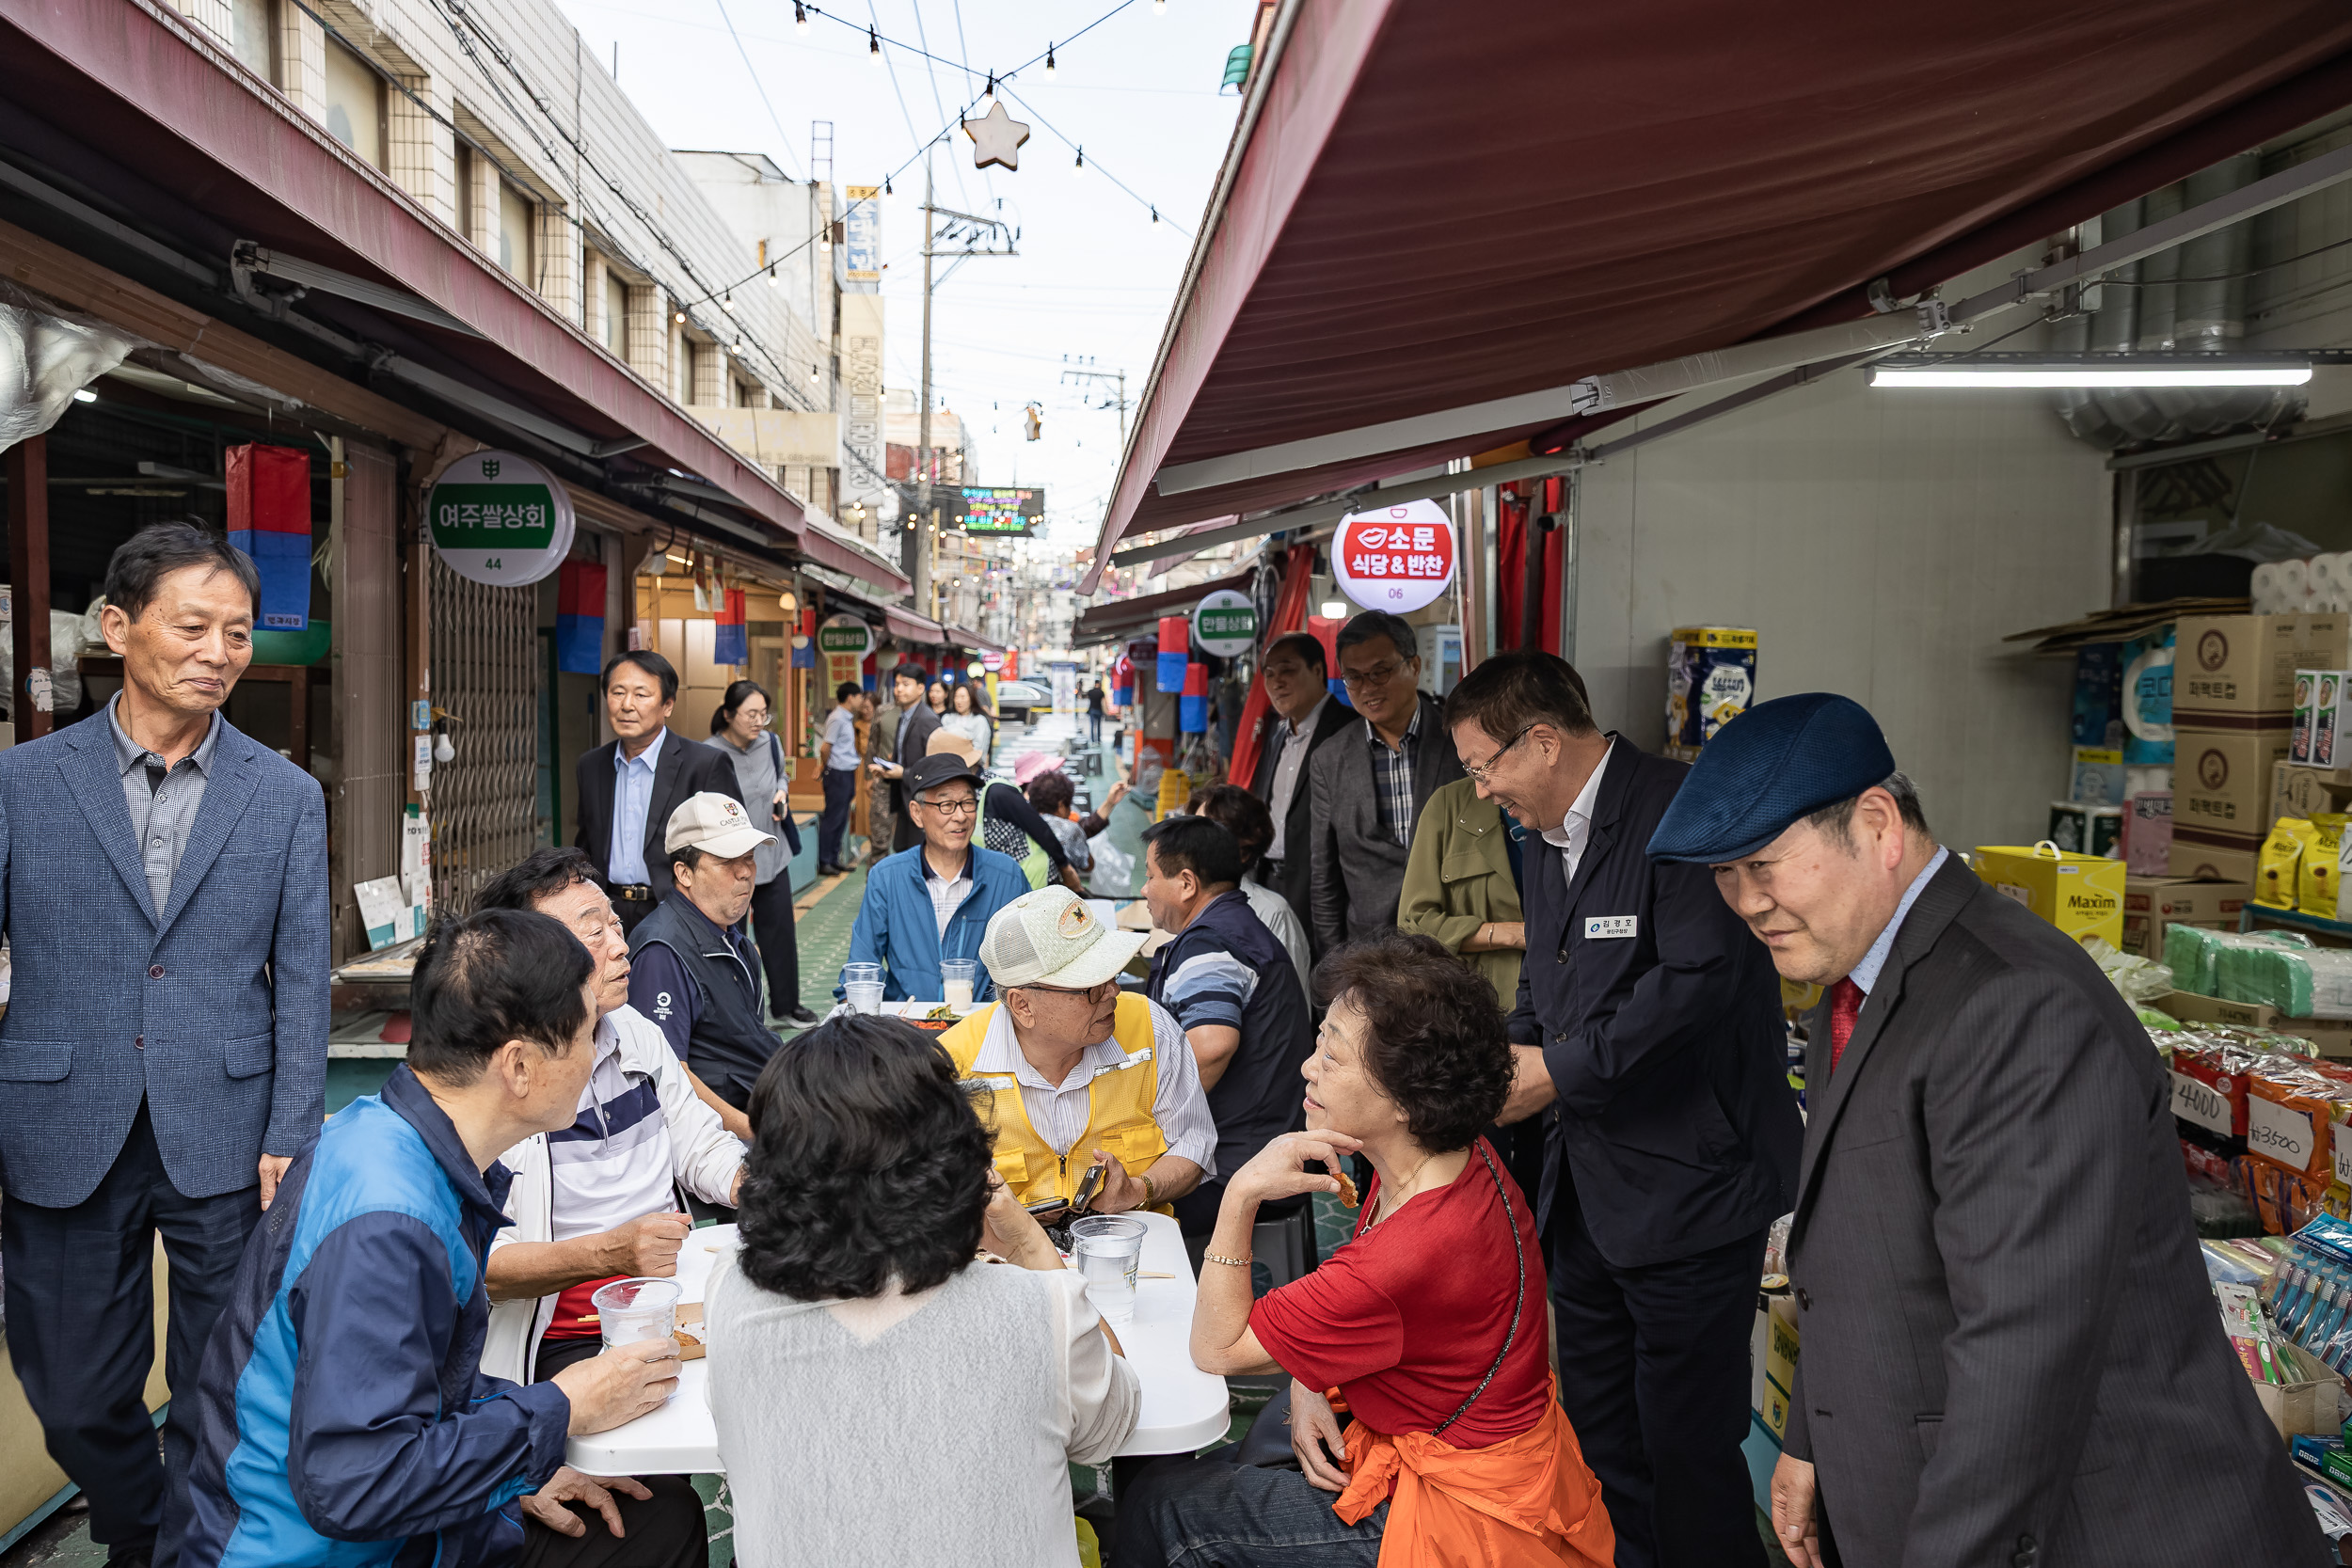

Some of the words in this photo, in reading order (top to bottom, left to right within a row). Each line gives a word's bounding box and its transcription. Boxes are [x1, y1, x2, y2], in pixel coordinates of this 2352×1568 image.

[439, 504, 546, 529] 여주쌀상회
[1388, 527, 1436, 551] 소문
[485, 558, 501, 570] 44
[1352, 554, 1390, 576] 식당
[1391, 555, 1406, 574] &
[1407, 555, 1444, 577] 반찬
[1389, 588, 1404, 599] 06
[2067, 894, 2116, 909] Maxim
